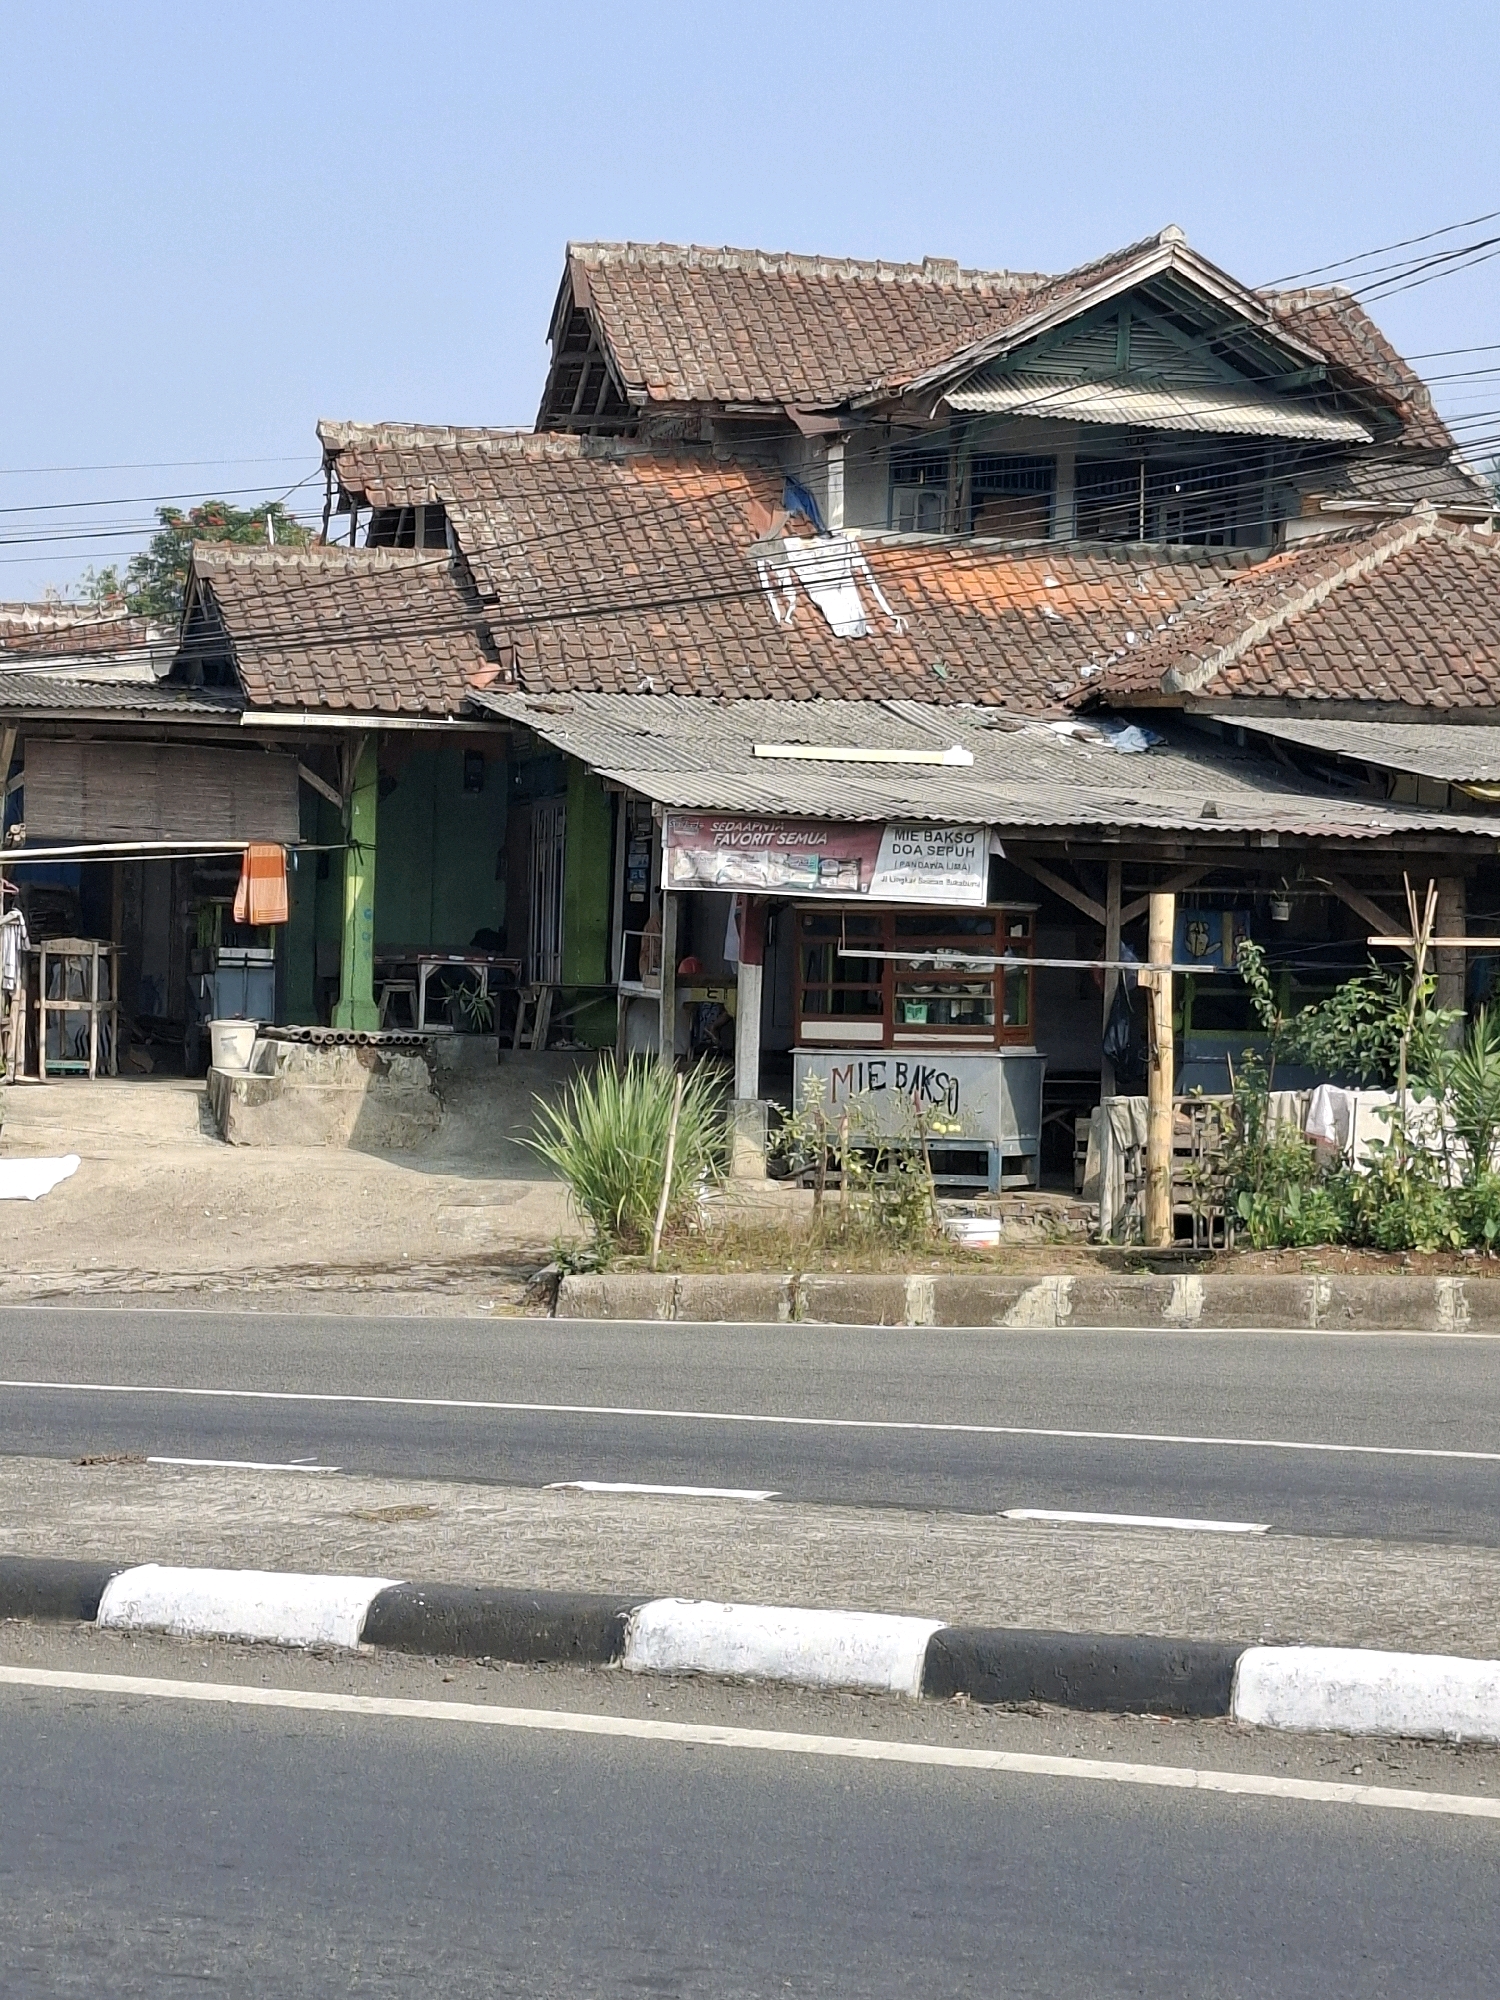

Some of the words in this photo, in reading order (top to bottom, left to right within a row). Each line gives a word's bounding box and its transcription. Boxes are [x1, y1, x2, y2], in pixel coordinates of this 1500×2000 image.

[713, 832, 774, 846] FAVORIT
[776, 833, 828, 845] SEMUA
[894, 828, 920, 842] MIE
[924, 830, 975, 844] BAKSO
[892, 843, 923, 856] DOA
[926, 845, 975, 858] SEPUH
[831, 1060, 887, 1104] MIE
[894, 1061, 959, 1116] BAKSO
